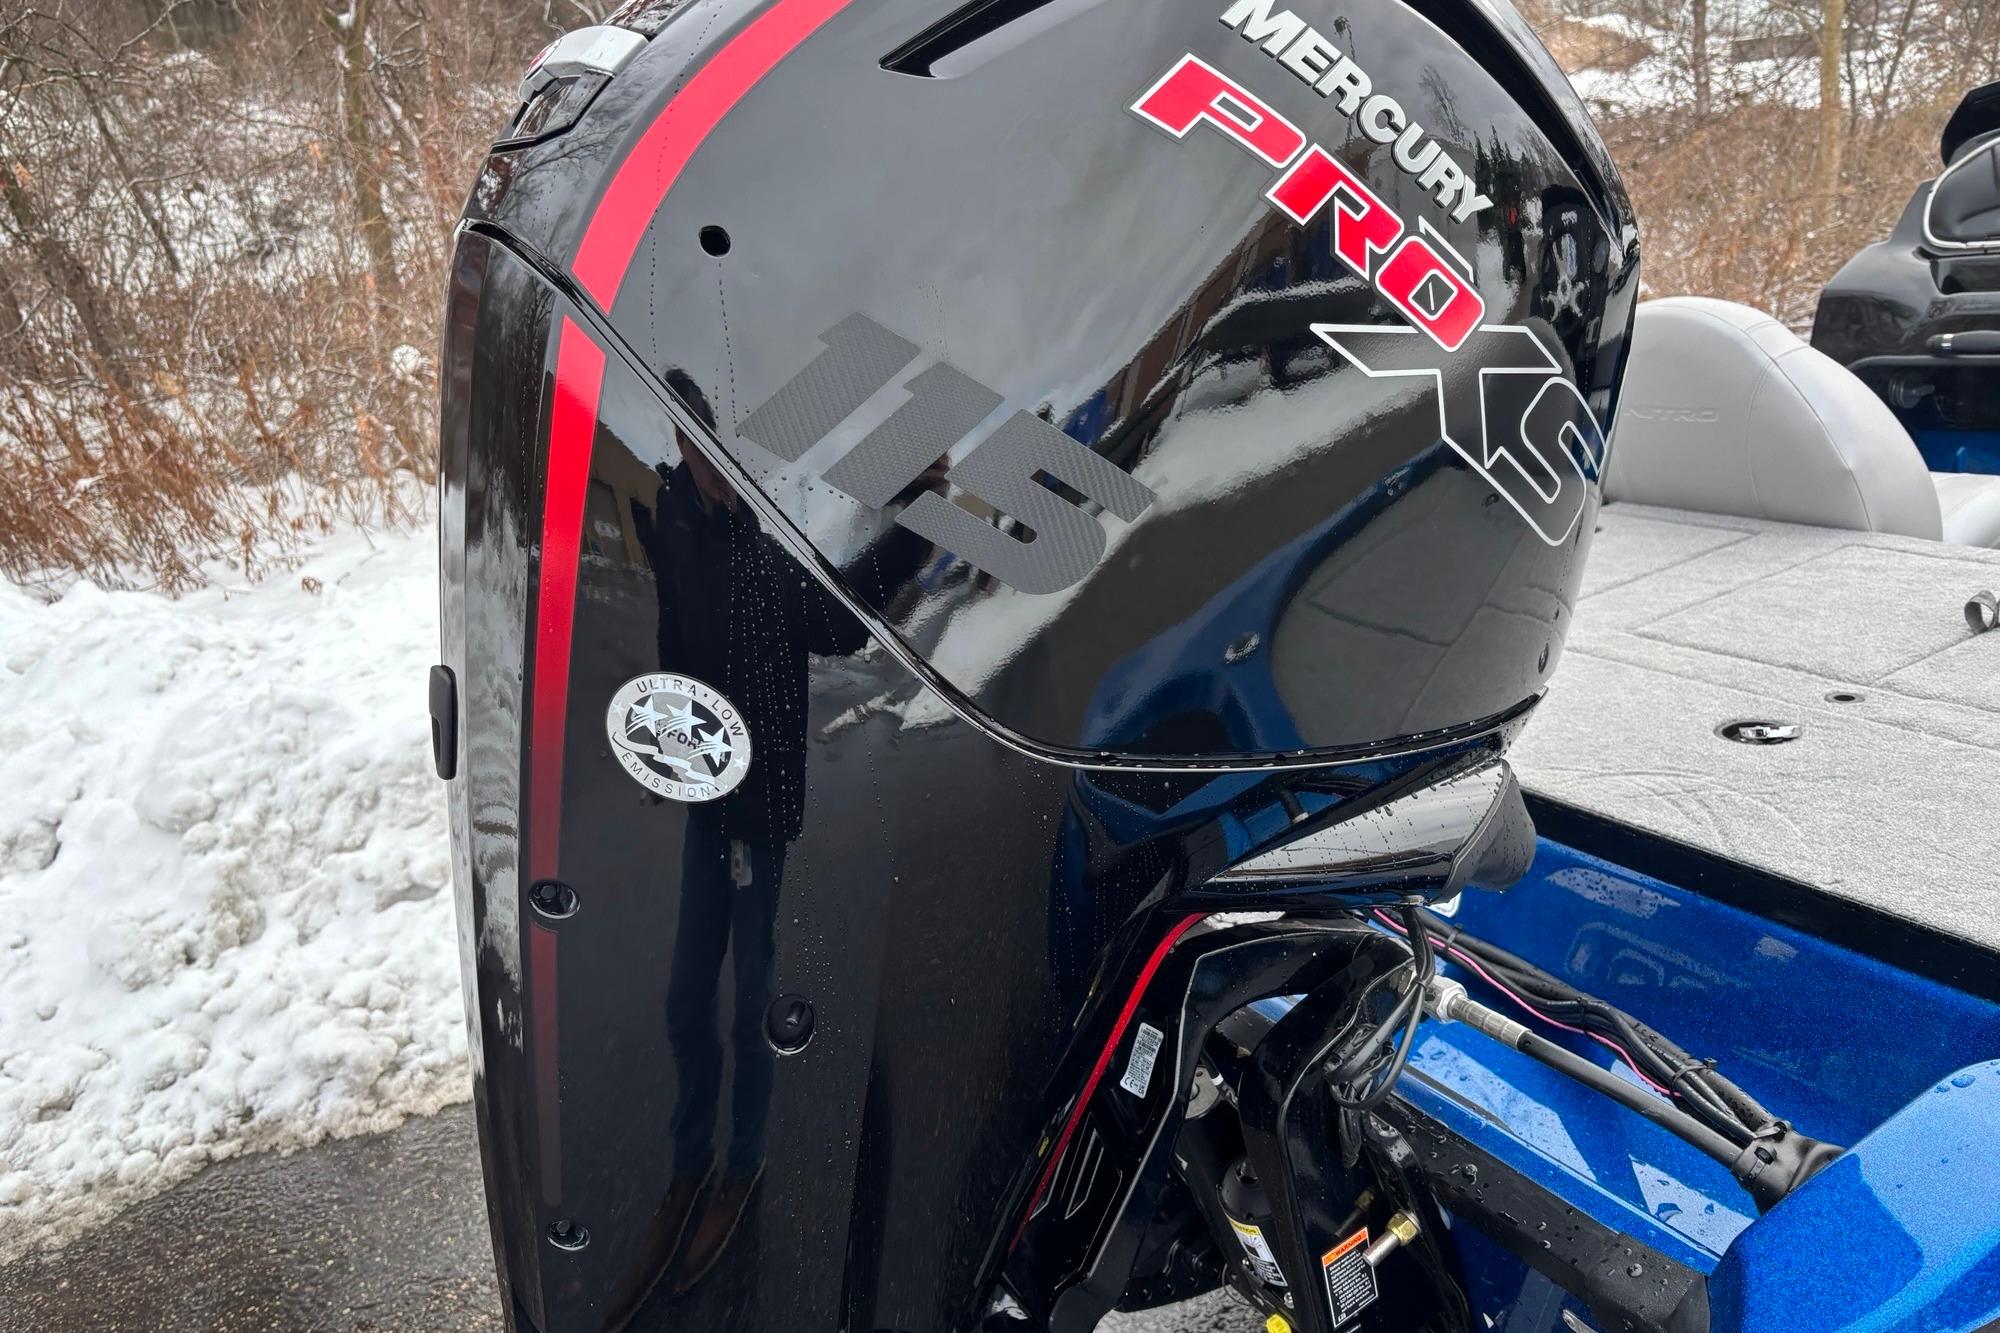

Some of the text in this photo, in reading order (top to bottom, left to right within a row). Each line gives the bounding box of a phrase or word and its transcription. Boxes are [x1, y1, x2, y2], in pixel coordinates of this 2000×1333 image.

[1130, 52, 1485, 352] PRO
[1219, 0, 1494, 224] MERCURY
[735, 311, 1158, 595] 115
[1309, 323, 1607, 546] XS
[621, 752, 712, 798] EMISSION
[636, 677, 744, 737] ULTRA LOW
